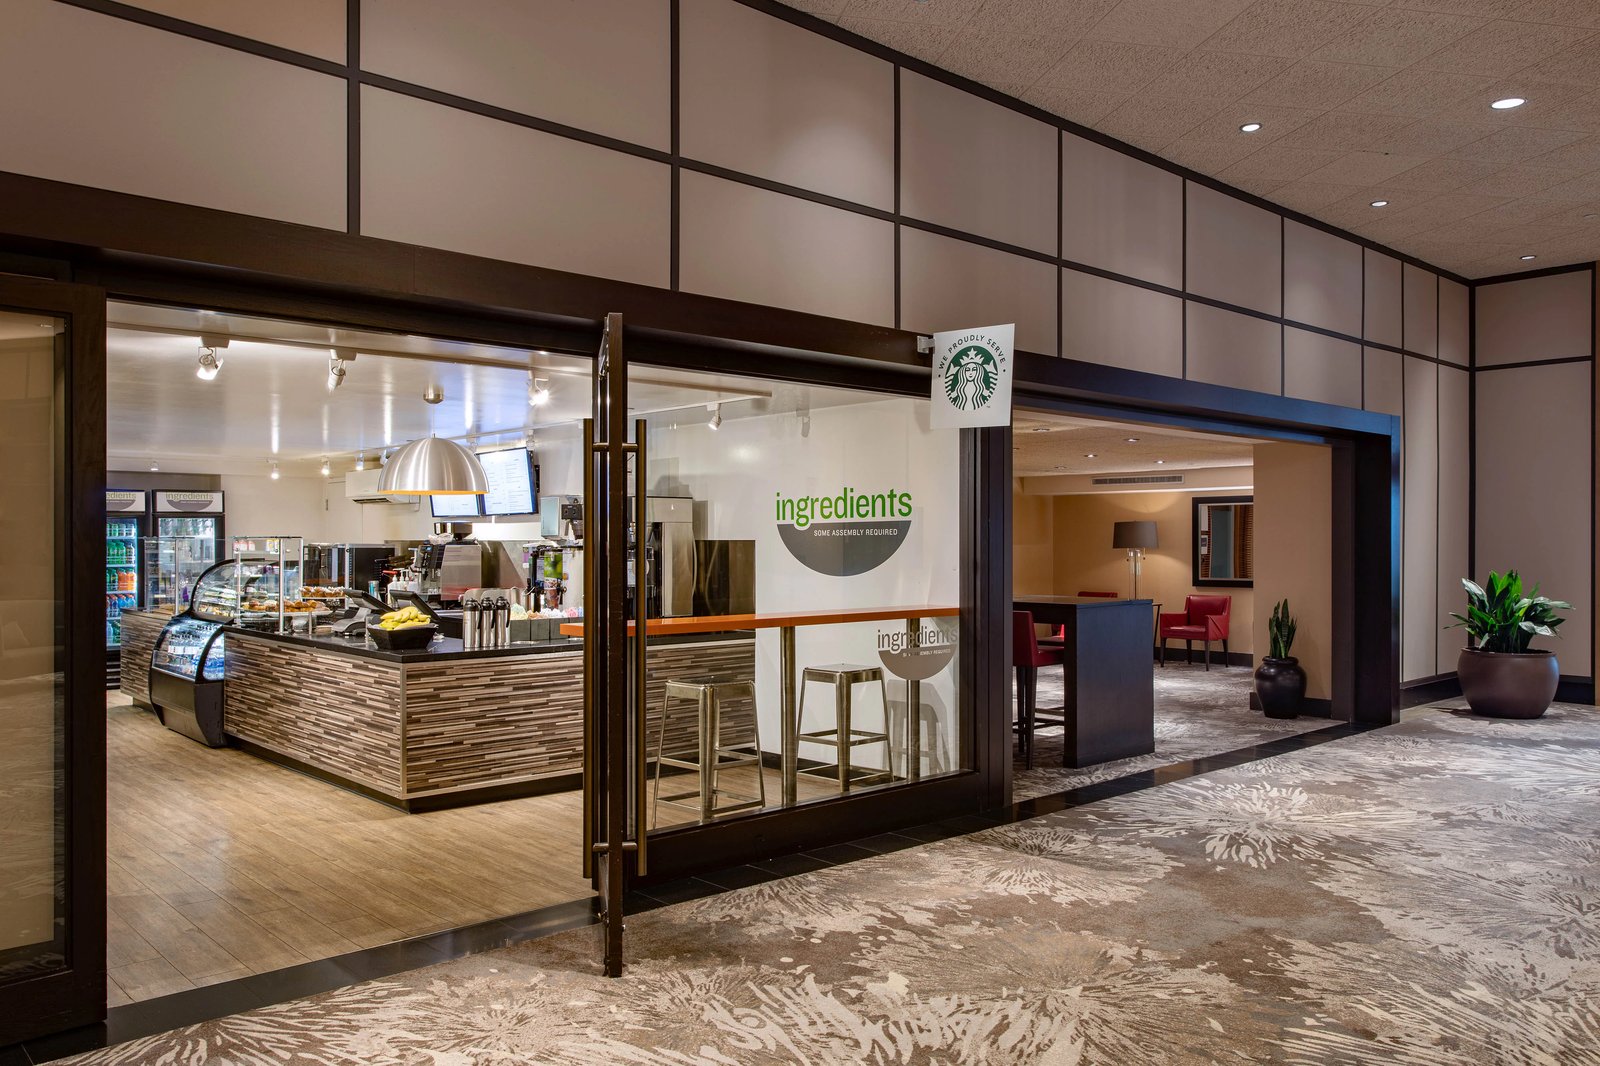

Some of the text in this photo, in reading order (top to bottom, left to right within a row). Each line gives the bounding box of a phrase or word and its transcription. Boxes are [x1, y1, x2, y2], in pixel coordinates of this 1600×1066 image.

[939, 335, 1006, 369] WE PROUDLY SERVE
[165, 491, 214, 501] ingredients
[776, 487, 913, 527] ingredients
[814, 529, 830, 537] SOME
[865, 528, 898, 536] REQUIRED
